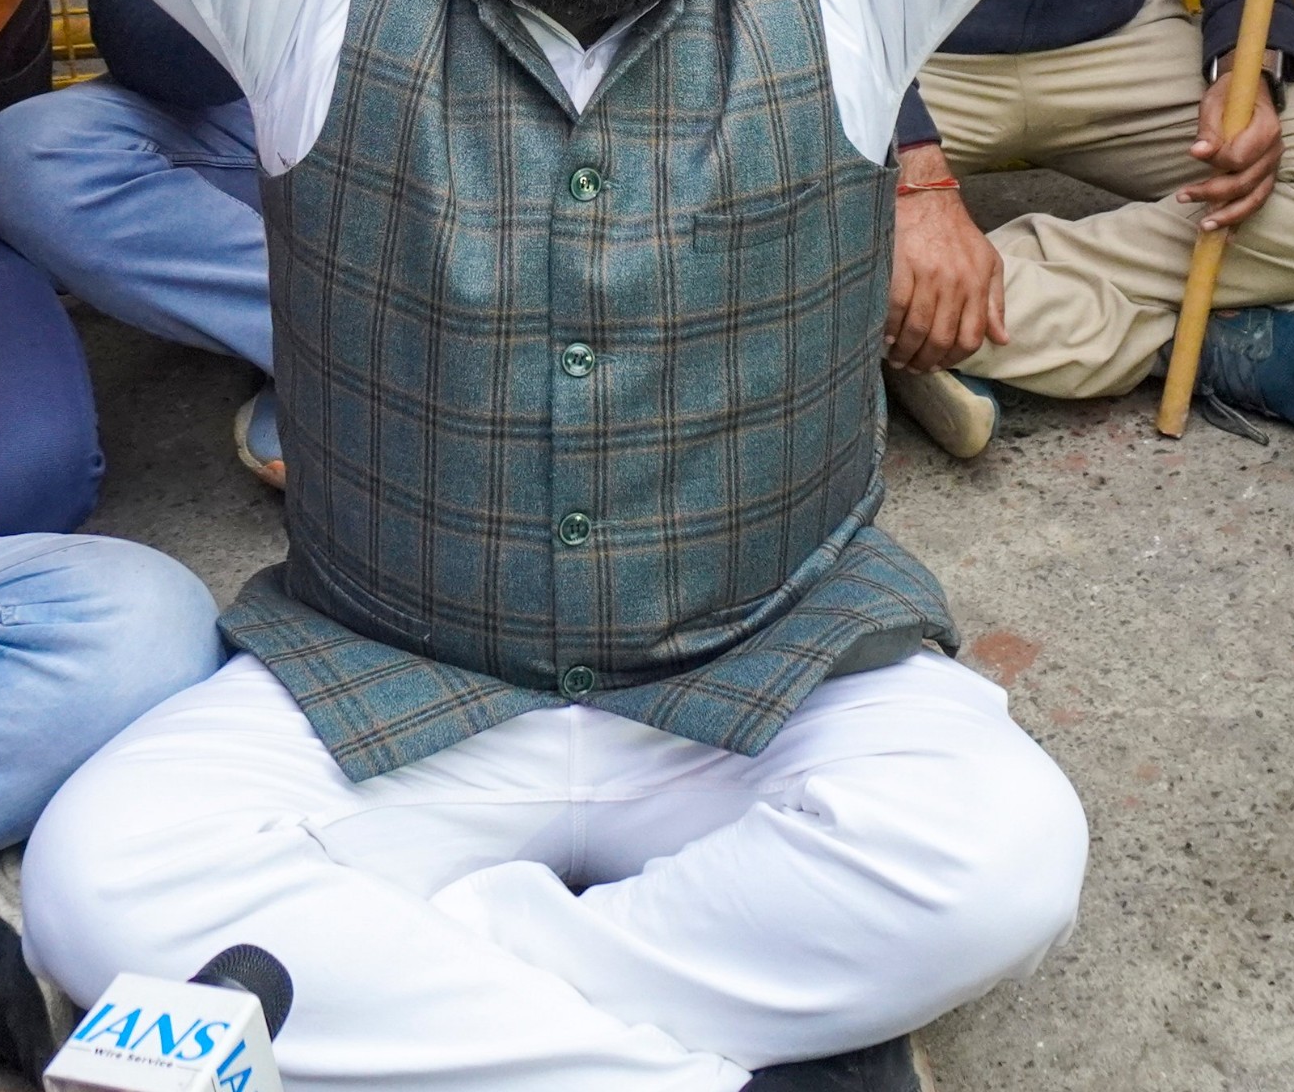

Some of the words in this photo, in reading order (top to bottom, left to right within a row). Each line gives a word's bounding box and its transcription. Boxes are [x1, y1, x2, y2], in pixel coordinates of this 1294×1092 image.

[73, 1003, 231, 1062] IANS
[128, 1054, 173, 1068] Service
[216, 1039, 252, 1092] IA
